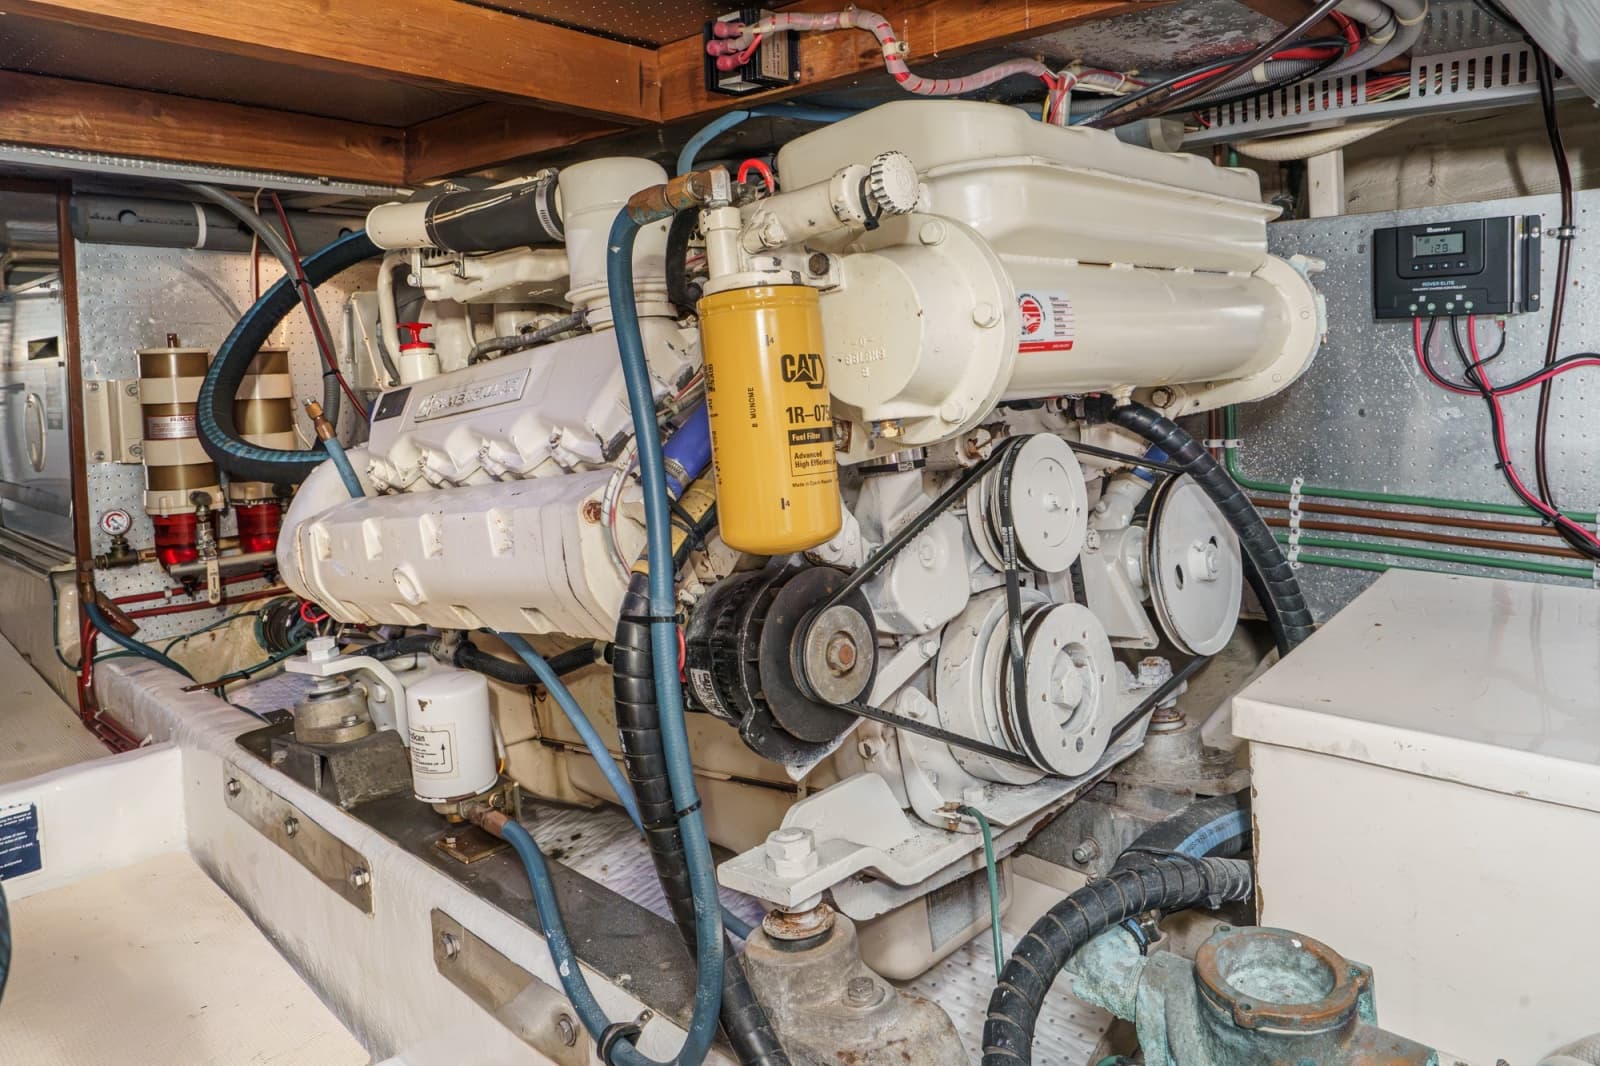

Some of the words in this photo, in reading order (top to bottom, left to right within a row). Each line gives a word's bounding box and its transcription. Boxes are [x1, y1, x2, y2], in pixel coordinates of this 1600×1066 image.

[781, 353, 824, 386] CAT
[791, 432, 806, 441] Fuel
[806, 432, 821, 440] Filter
[794, 450, 822, 459] Advanced
[795, 459, 810, 469] High
